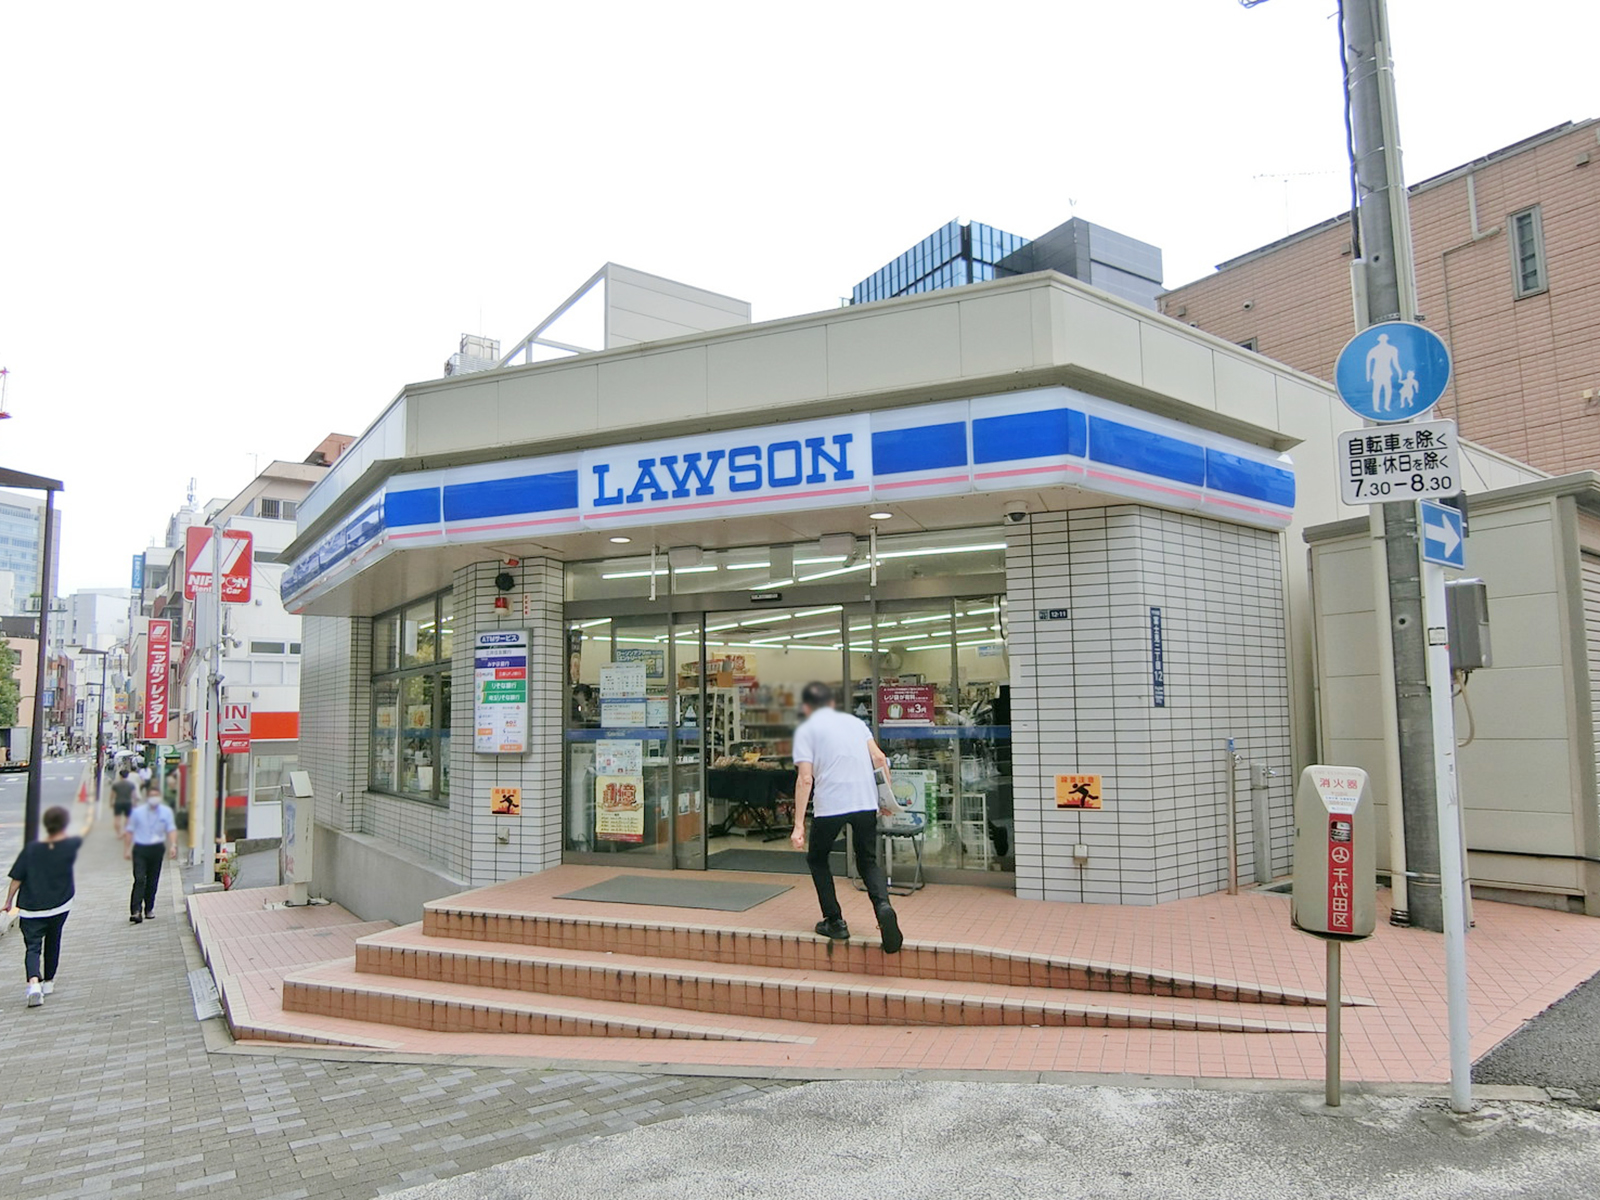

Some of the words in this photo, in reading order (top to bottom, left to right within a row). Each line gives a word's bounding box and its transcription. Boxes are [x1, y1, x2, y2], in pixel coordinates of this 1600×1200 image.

[1349, 430, 1447, 455] 自転車を除く
[592, 433, 854, 507] LAWSON
[149, 644, 167, 733] ニッポンレンタカー
[225, 705, 247, 719] IN
[1320, 778, 1358, 789] 消火器
[1332, 868, 1349, 927] 千代田区
